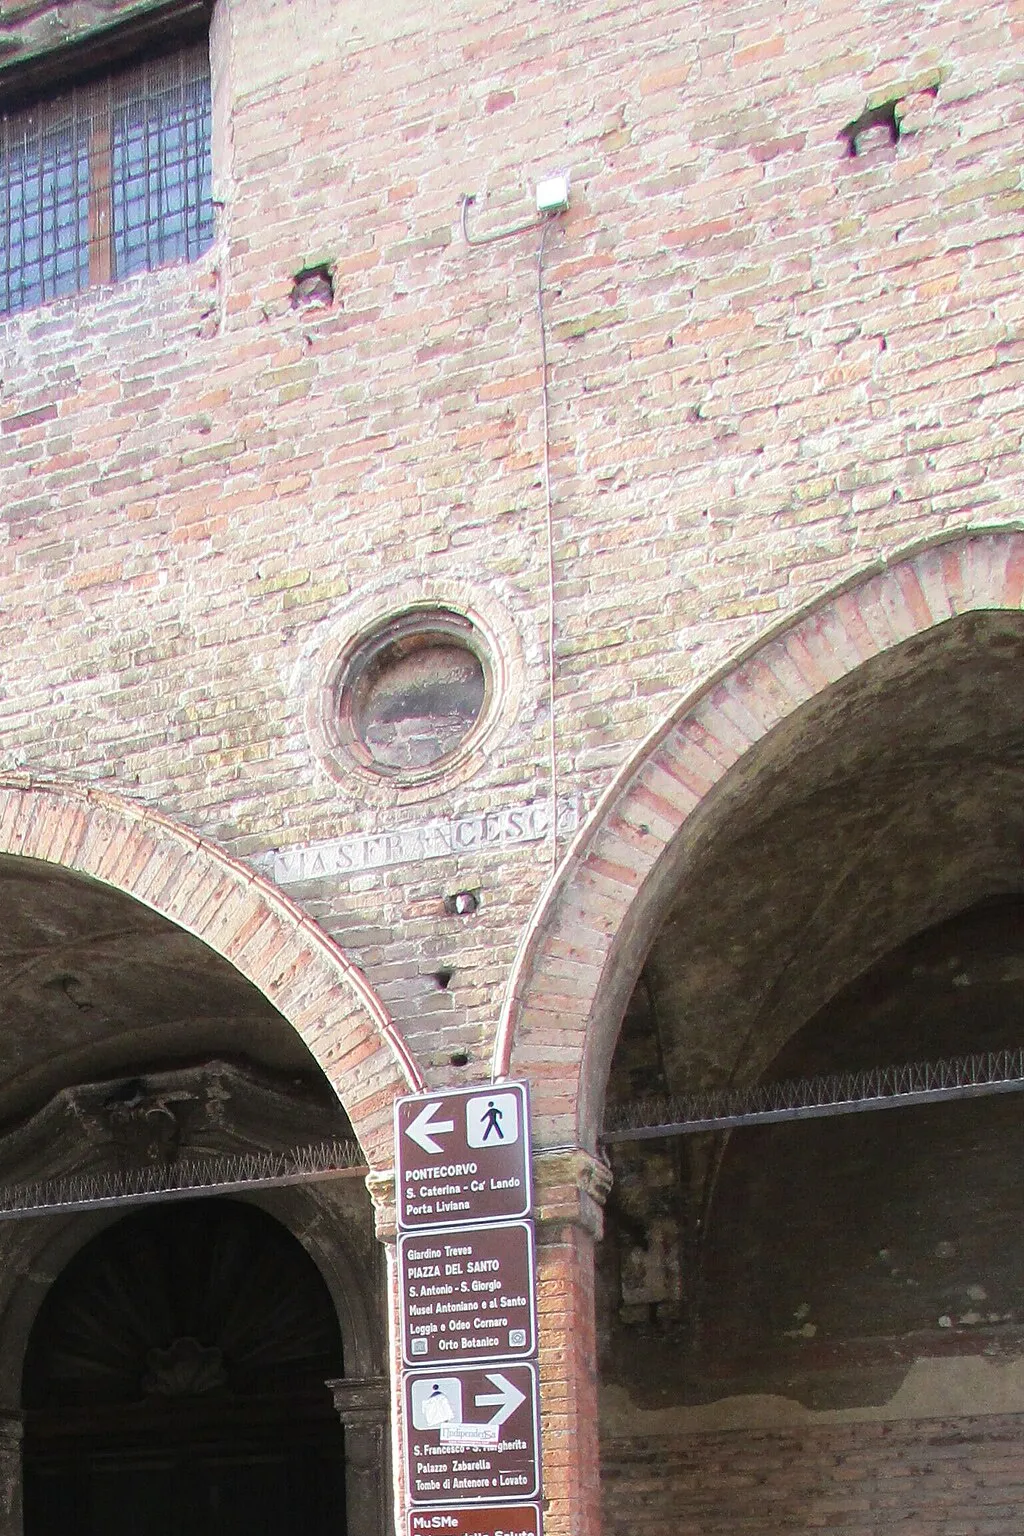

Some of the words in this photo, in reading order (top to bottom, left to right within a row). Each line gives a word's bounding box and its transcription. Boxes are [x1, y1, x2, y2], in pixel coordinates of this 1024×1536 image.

[279, 852, 326, 880] VIA
[336, 844, 353, 868] S
[406, 1163, 477, 1181] PONTECORVO
[406, 1188, 416, 1198] S.
[420, 1185, 460, 1197] Caterina
[491, 1177, 520, 1189] Lando
[407, 1204, 432, 1215] Porta
[436, 1201, 470, 1212] Liviana
[408, 1249, 441, 1260] Giardino
[444, 1246, 472, 1256] Treves
[408, 1266, 440, 1279] PIAZZA
[445, 1263, 463, 1275] DEL
[467, 1260, 499, 1273] SANTO
[409, 1287, 418, 1297] S.
[420, 1284, 452, 1296] Antonio
[461, 1282, 470, 1292] S.
[472, 1280, 501, 1292] Giorgio
[410, 1304, 432, 1316] Musei
[436, 1301, 478, 1313] Antoniano
[482, 1301, 486, 1309] e
[489, 1298, 497, 1308] al
[500, 1296, 526, 1307] Santo
[410, 1323, 437, 1335] Loggia
[449, 1320, 470, 1330] Odeo
[474, 1318, 507, 1328] Cornaro
[439, 1340, 458, 1350] Orto
[462, 1337, 499, 1348] Botanico
[414, 1446, 422, 1456] S.
[424, 1445, 464, 1455] Francesco
[417, 1463, 447, 1473] Palazzo
[453, 1460, 491, 1471] Zabarella
[416, 1480, 440, 1491] Tombe
[443, 1479, 450, 1489] di
[453, 1478, 489, 1488] Antenore
[500, 1475, 527, 1486] Lovato
[413, 1516, 458, 1528] MuSMe
